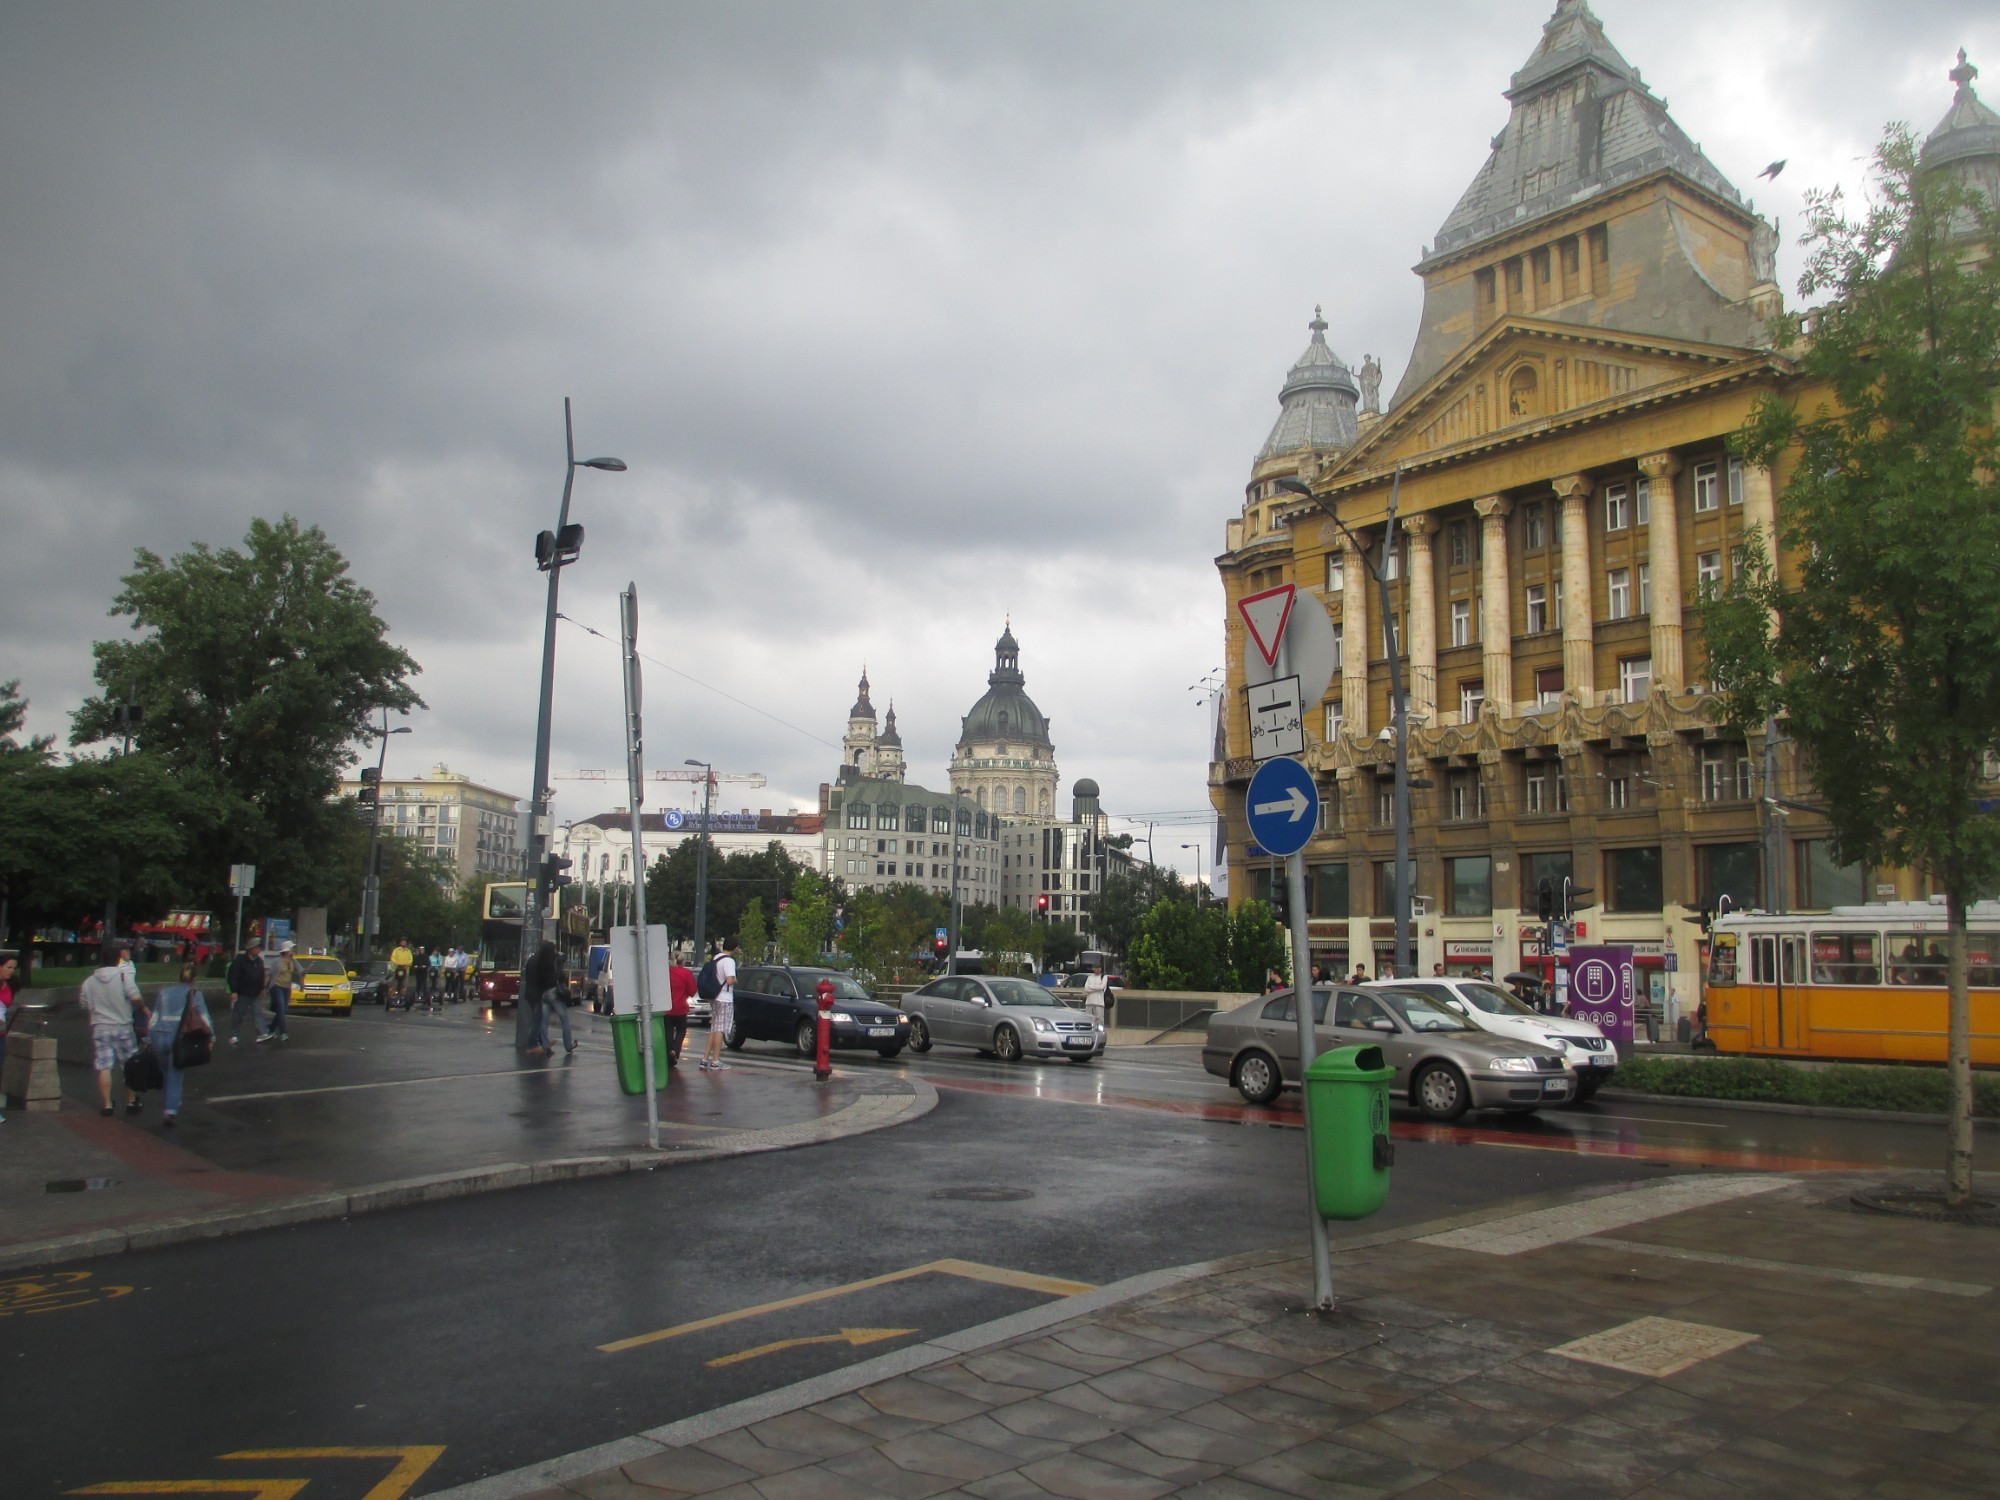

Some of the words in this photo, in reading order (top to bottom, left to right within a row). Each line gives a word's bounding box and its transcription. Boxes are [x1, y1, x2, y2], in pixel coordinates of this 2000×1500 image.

[1480, 945, 1491, 953] Bank
[1632, 945, 1646, 953] Credit
[1647, 945, 1661, 953] Bank
